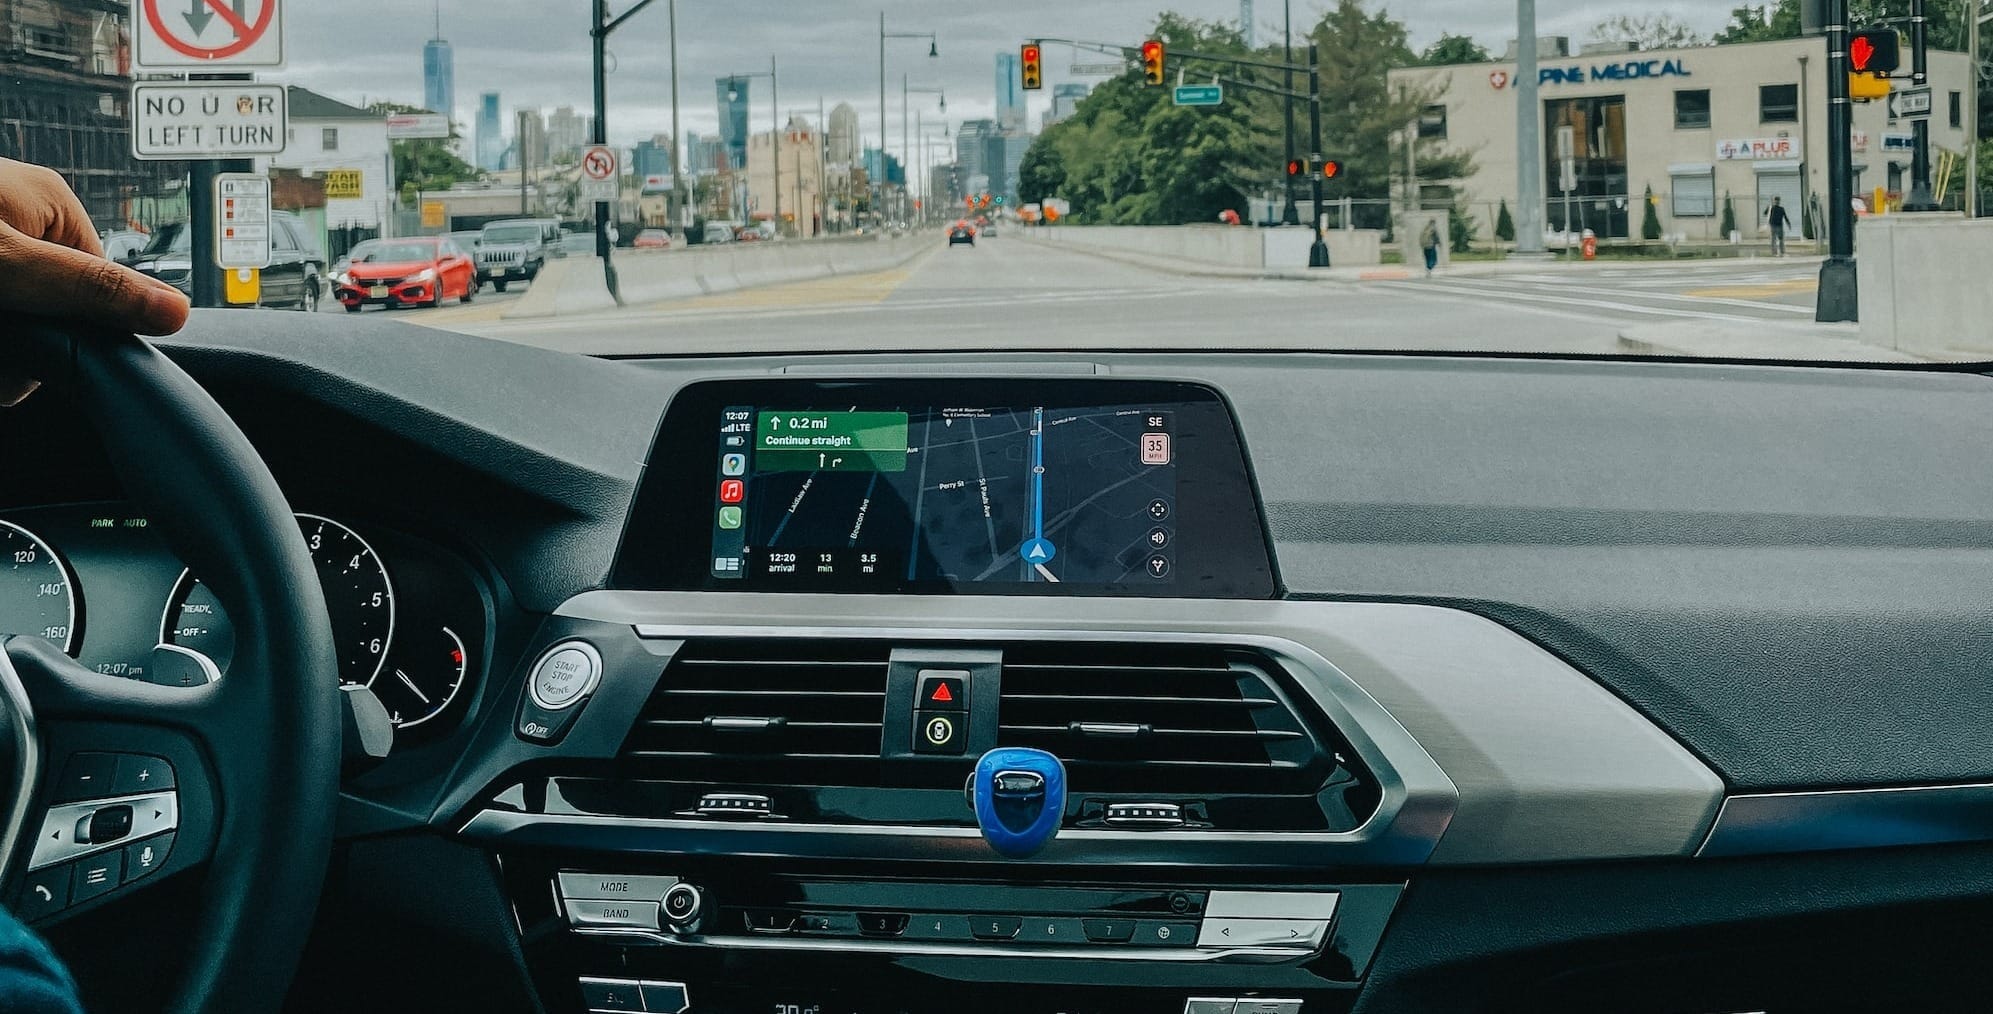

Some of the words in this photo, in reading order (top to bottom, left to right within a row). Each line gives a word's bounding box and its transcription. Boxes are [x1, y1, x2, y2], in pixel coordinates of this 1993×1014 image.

[1591, 60, 1692, 80] MEDICAL
[146, 97, 185, 116] NO
[202, 97, 219, 115] U
[149, 126, 202, 146] LEFT
[216, 126, 273, 145] TURN
[725, 412, 749, 420] 12:07
[1148, 417, 1162, 426] SE
[790, 418, 810, 429] 0.2
[811, 417, 827, 429] mi
[765, 436, 810, 445] Continue
[811, 436, 851, 447] straight
[1149, 440, 1162, 451] 35
[802, 478, 813, 491] Ave
[939, 481, 957, 490] Perry
[91, 519, 114, 527] PARK
[123, 519, 147, 527] AUTO
[850, 512, 865, 539] Beacon
[859, 499, 869, 513] Ave
[310, 535, 321, 549] 3
[14, 551, 35, 563] 120
[349, 555, 360, 569] 4
[769, 553, 796, 562] 12:20
[820, 553, 832, 562] 13
[861, 553, 877, 562] 3.5
[768, 564, 795, 572] arrival
[817, 564, 833, 572] min
[863, 564, 874, 573] mi
[39, 583, 60, 595] 140
[371, 592, 382, 607] 5
[184, 604, 209, 613] READY
[183, 627, 199, 636] OFF
[370, 638, 381, 653] 6
[96, 663, 127, 674] 12:07
[129, 667, 143, 676] pm
[554, 661, 580, 672] START
[551, 671, 573, 681] STOP
[543, 682, 569, 694] ENGINE
[601, 882, 628, 891] MODE
[603, 909, 629, 918] BAND
[822, 919, 828, 929] 2
[934, 921, 940, 931] 4
[992, 922, 998, 933] 5
[1047, 924, 1054, 934] 6
[1106, 925, 1112, 935] 7
